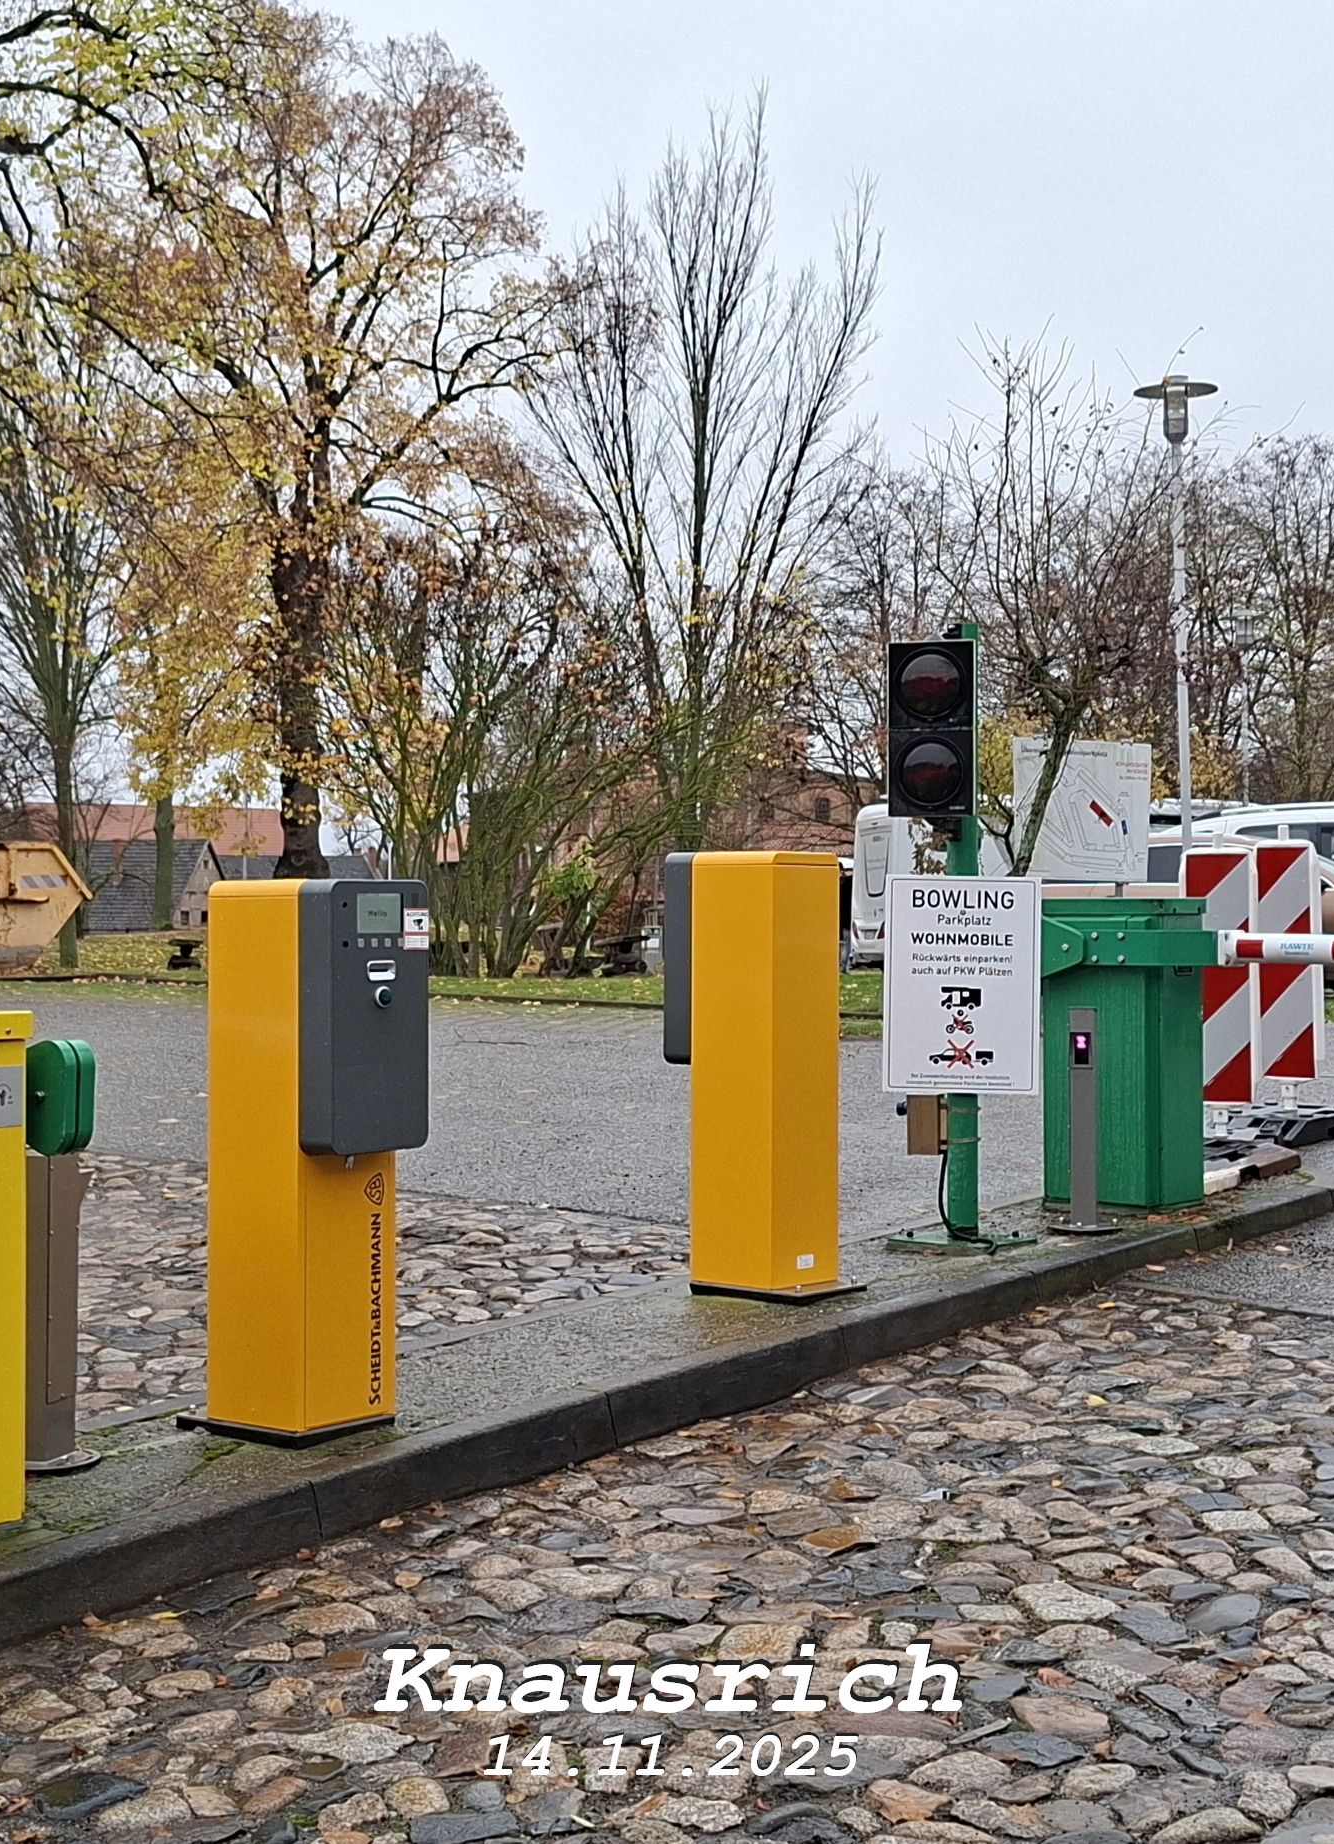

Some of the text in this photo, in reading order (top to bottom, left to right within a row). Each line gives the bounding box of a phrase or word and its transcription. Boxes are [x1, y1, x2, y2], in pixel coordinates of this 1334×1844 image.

[912, 889, 1015, 910] BOWLING
[936, 912, 993, 927] Parkplatz
[910, 932, 1014, 947] WOHNMOBILE
[912, 952, 1013, 965] Rückwärts einparken!
[911, 965, 1013, 977] auch auf PKW Plätzen
